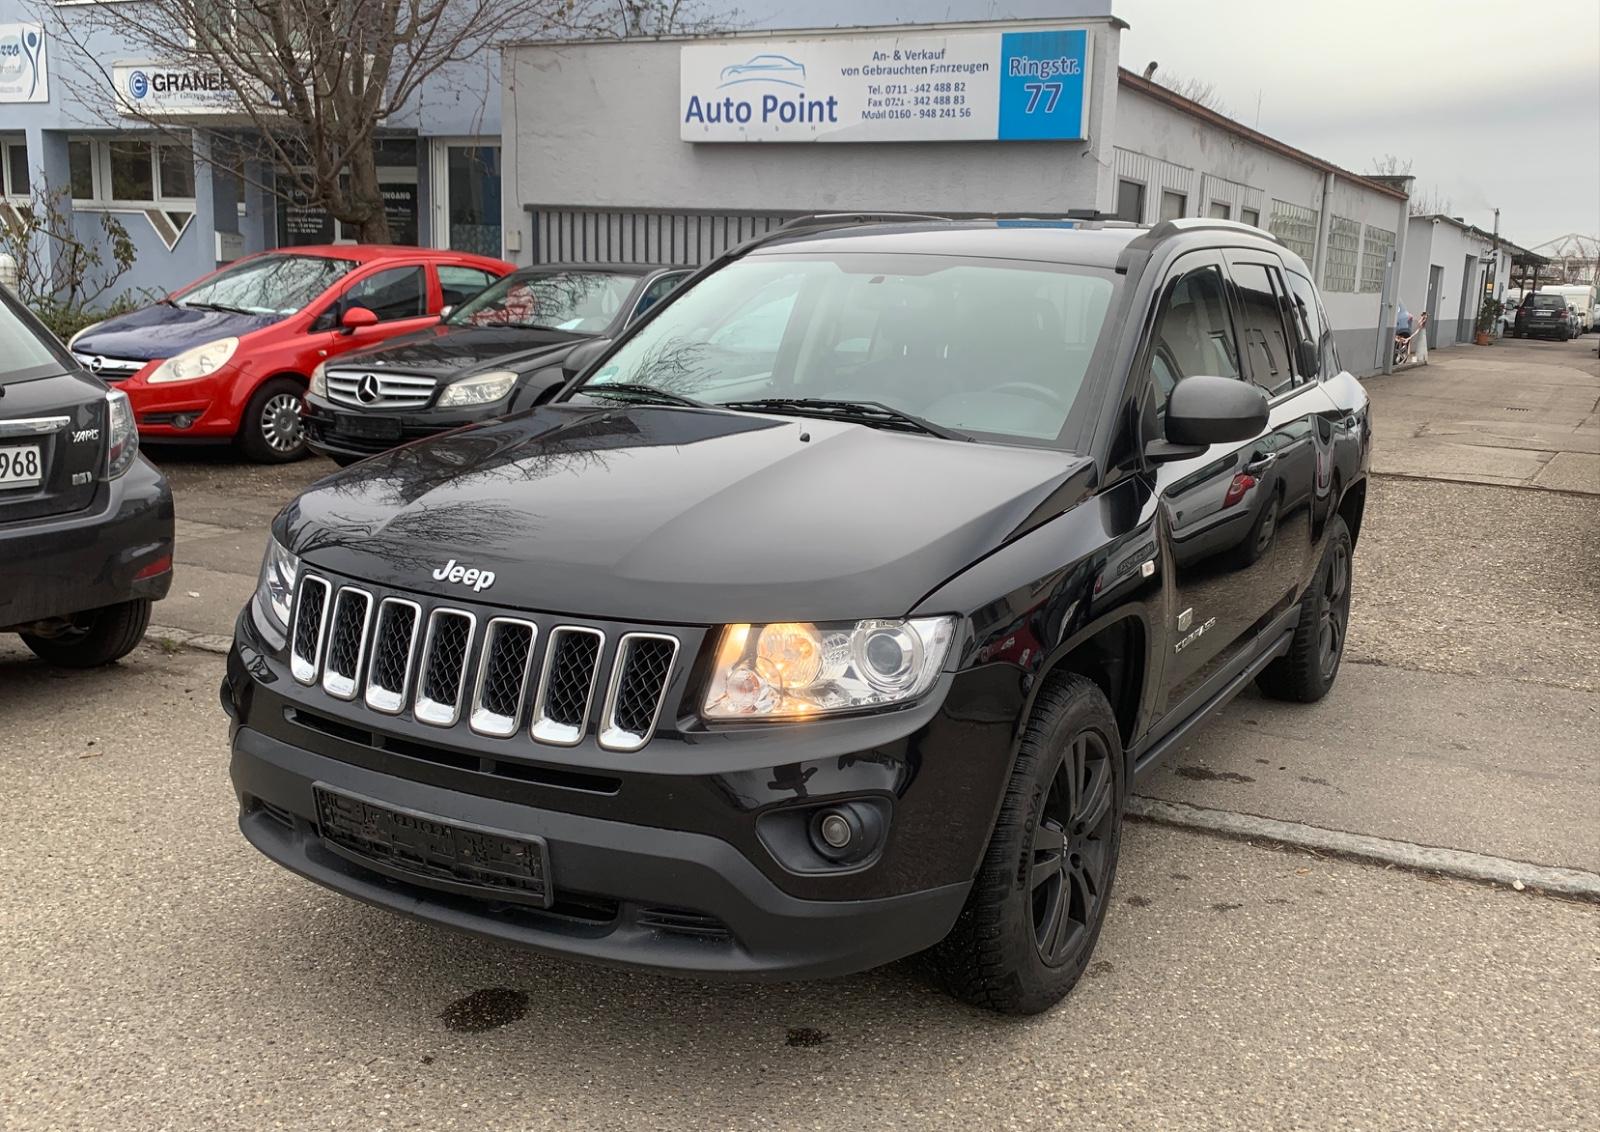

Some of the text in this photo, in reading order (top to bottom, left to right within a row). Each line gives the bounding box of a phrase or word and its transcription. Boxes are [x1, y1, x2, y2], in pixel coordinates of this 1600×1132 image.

[0, 44, 19, 56] zzo
[873, 48, 945, 61] An- & Verkauf
[841, 67, 859, 76] von
[862, 64, 927, 76] Gebrauchten
[1009, 56, 1081, 79] Ringstr.
[868, 85, 883, 95] Tel.
[885, 85, 907, 94] 0711
[934, 83, 951, 93] 488
[954, 82, 966, 92] 82
[868, 98, 882, 107] Fax
[913, 96, 930, 106] 342
[933, 96, 951, 105] 488
[953, 95, 965, 105] 83
[1024, 82, 1063, 114] 77
[685, 92, 838, 124] Auto Point
[888, 109, 911, 119] 0160
[919, 109, 936, 118] 948
[939, 108, 956, 118] 241
[959, 108, 971, 118] 56
[432, 559, 496, 593] Jeep
